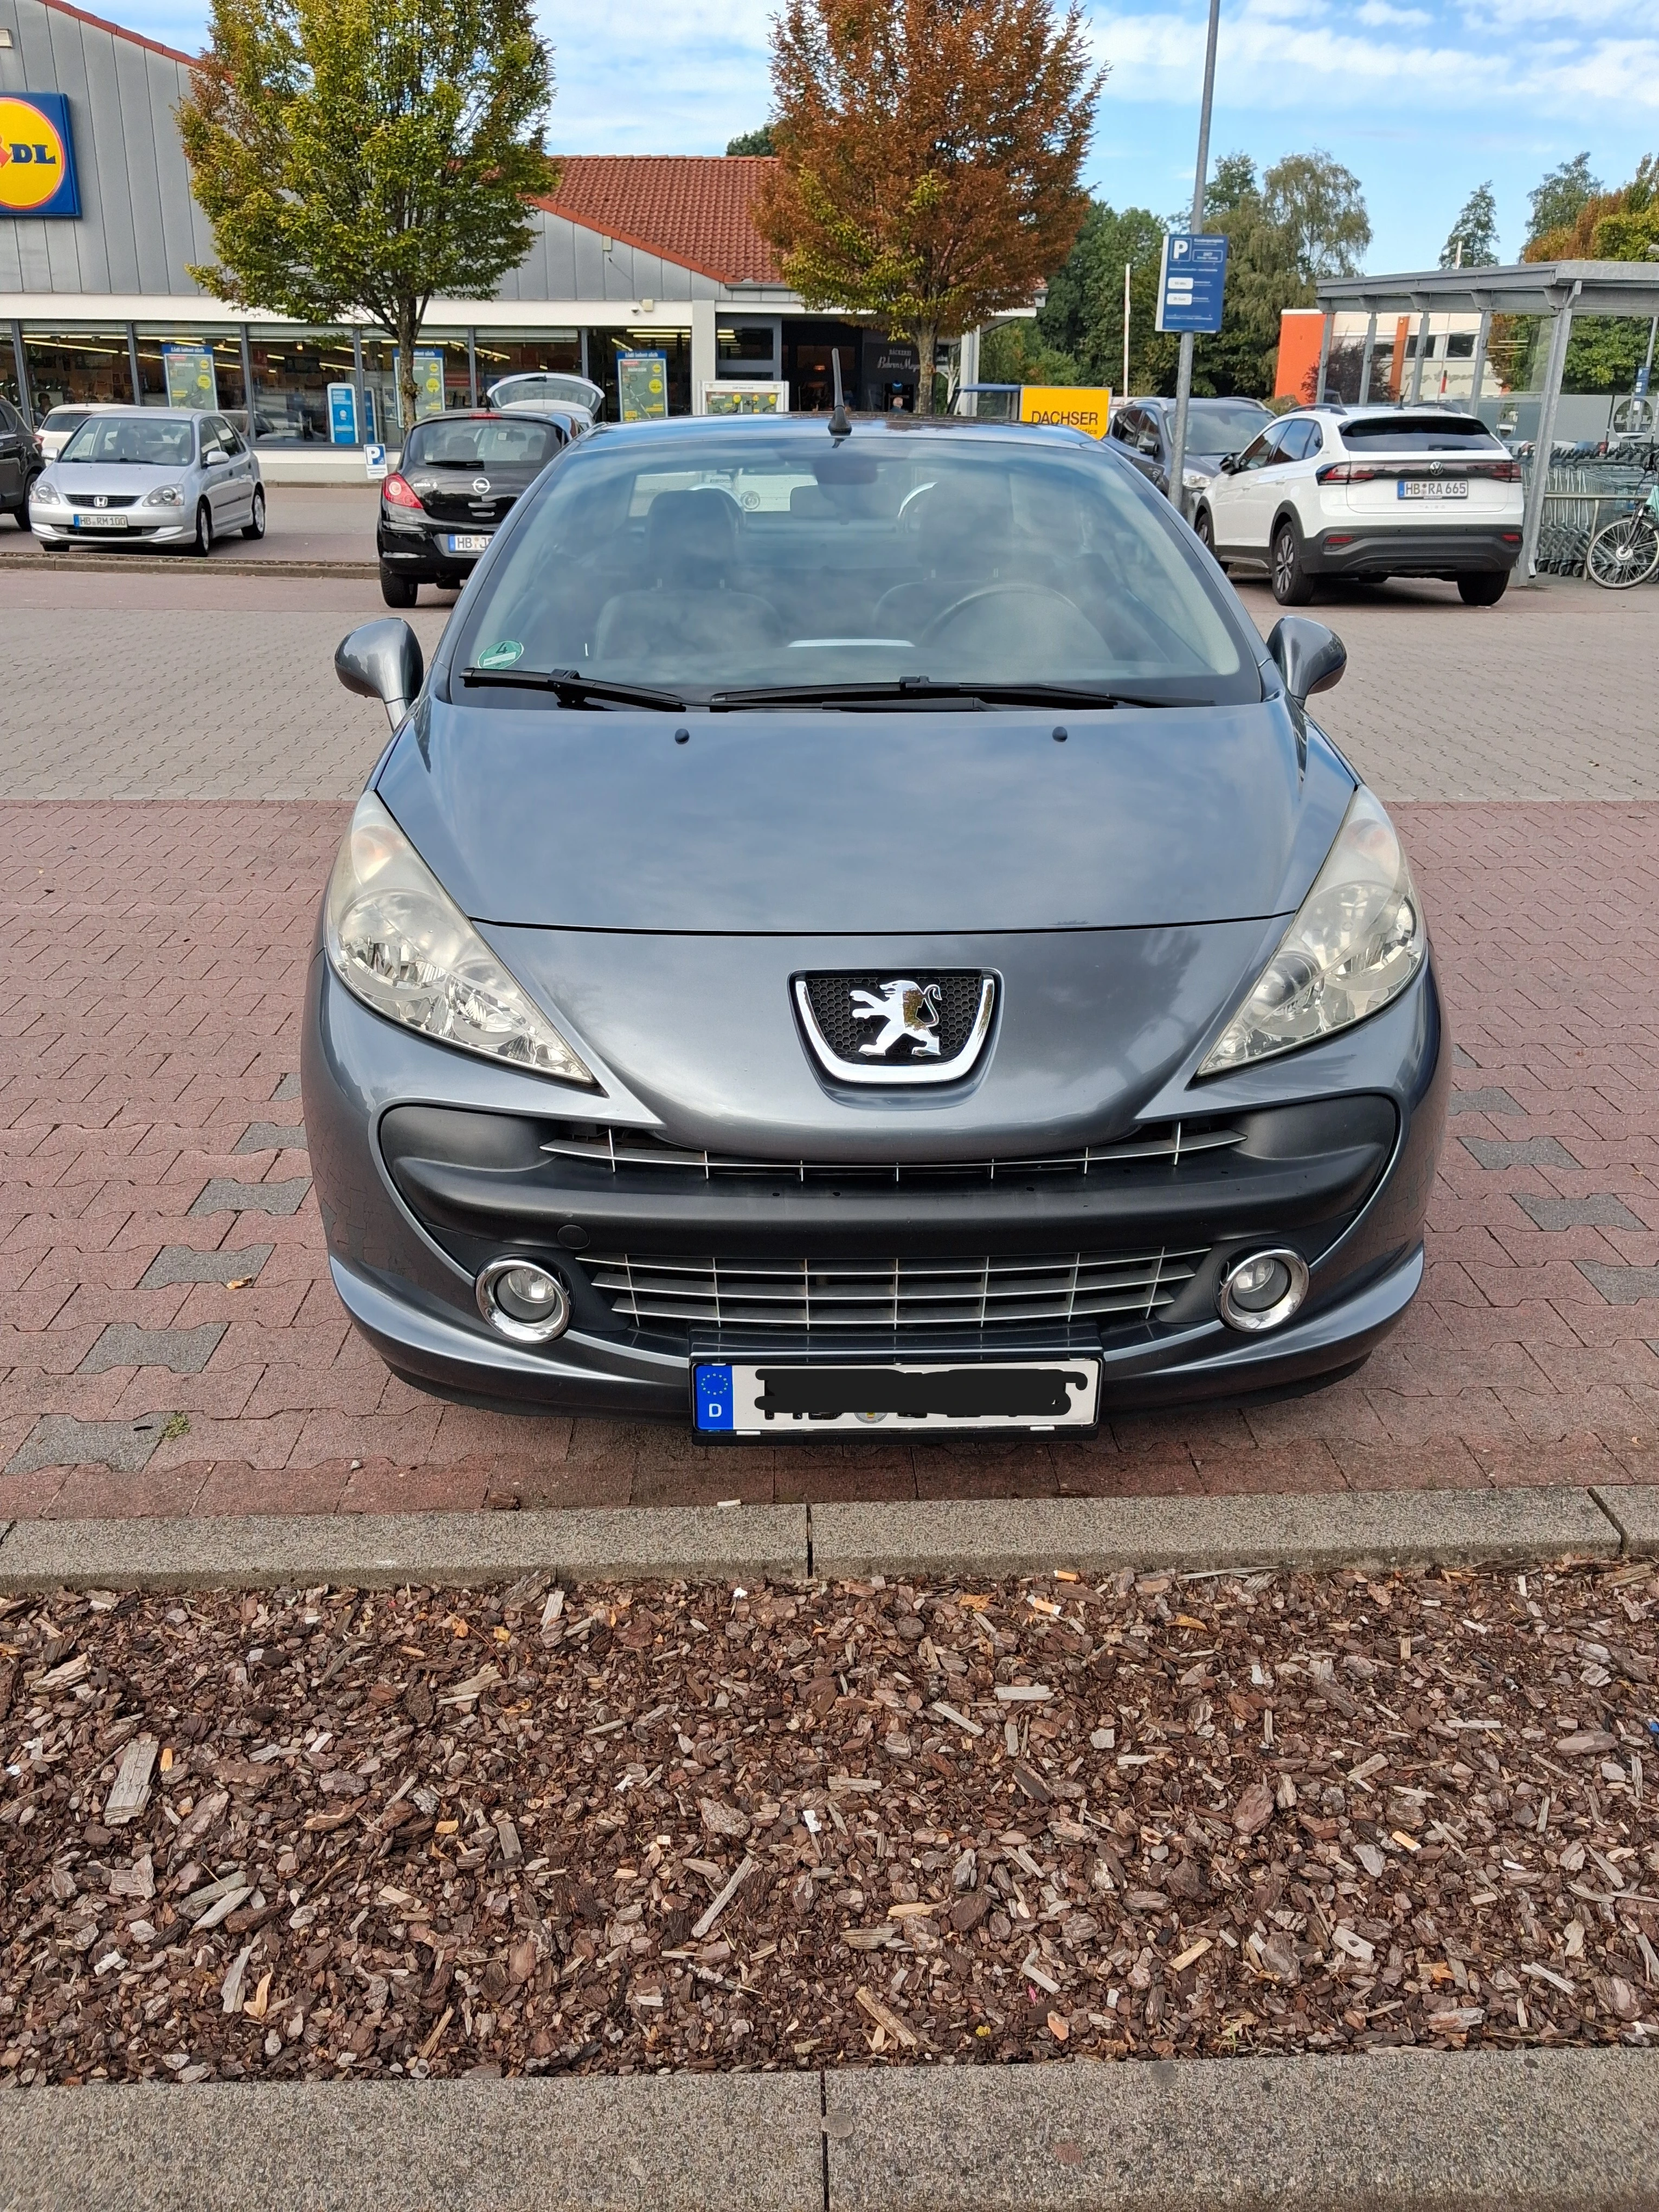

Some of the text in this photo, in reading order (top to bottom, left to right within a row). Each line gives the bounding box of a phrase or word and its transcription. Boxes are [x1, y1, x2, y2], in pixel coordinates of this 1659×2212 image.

[9, 143, 56, 164] DL
[1173, 240, 1188, 259] P
[1031, 410, 1098, 426] DACHSER
[366, 446, 381, 465] P
[1406, 483, 1467, 495] HB RA 665
[80, 517, 126, 526] HB RM 100
[457, 537, 472, 549] HB
[496, 642, 508, 654] 4
[709, 1403, 722, 1417] D
